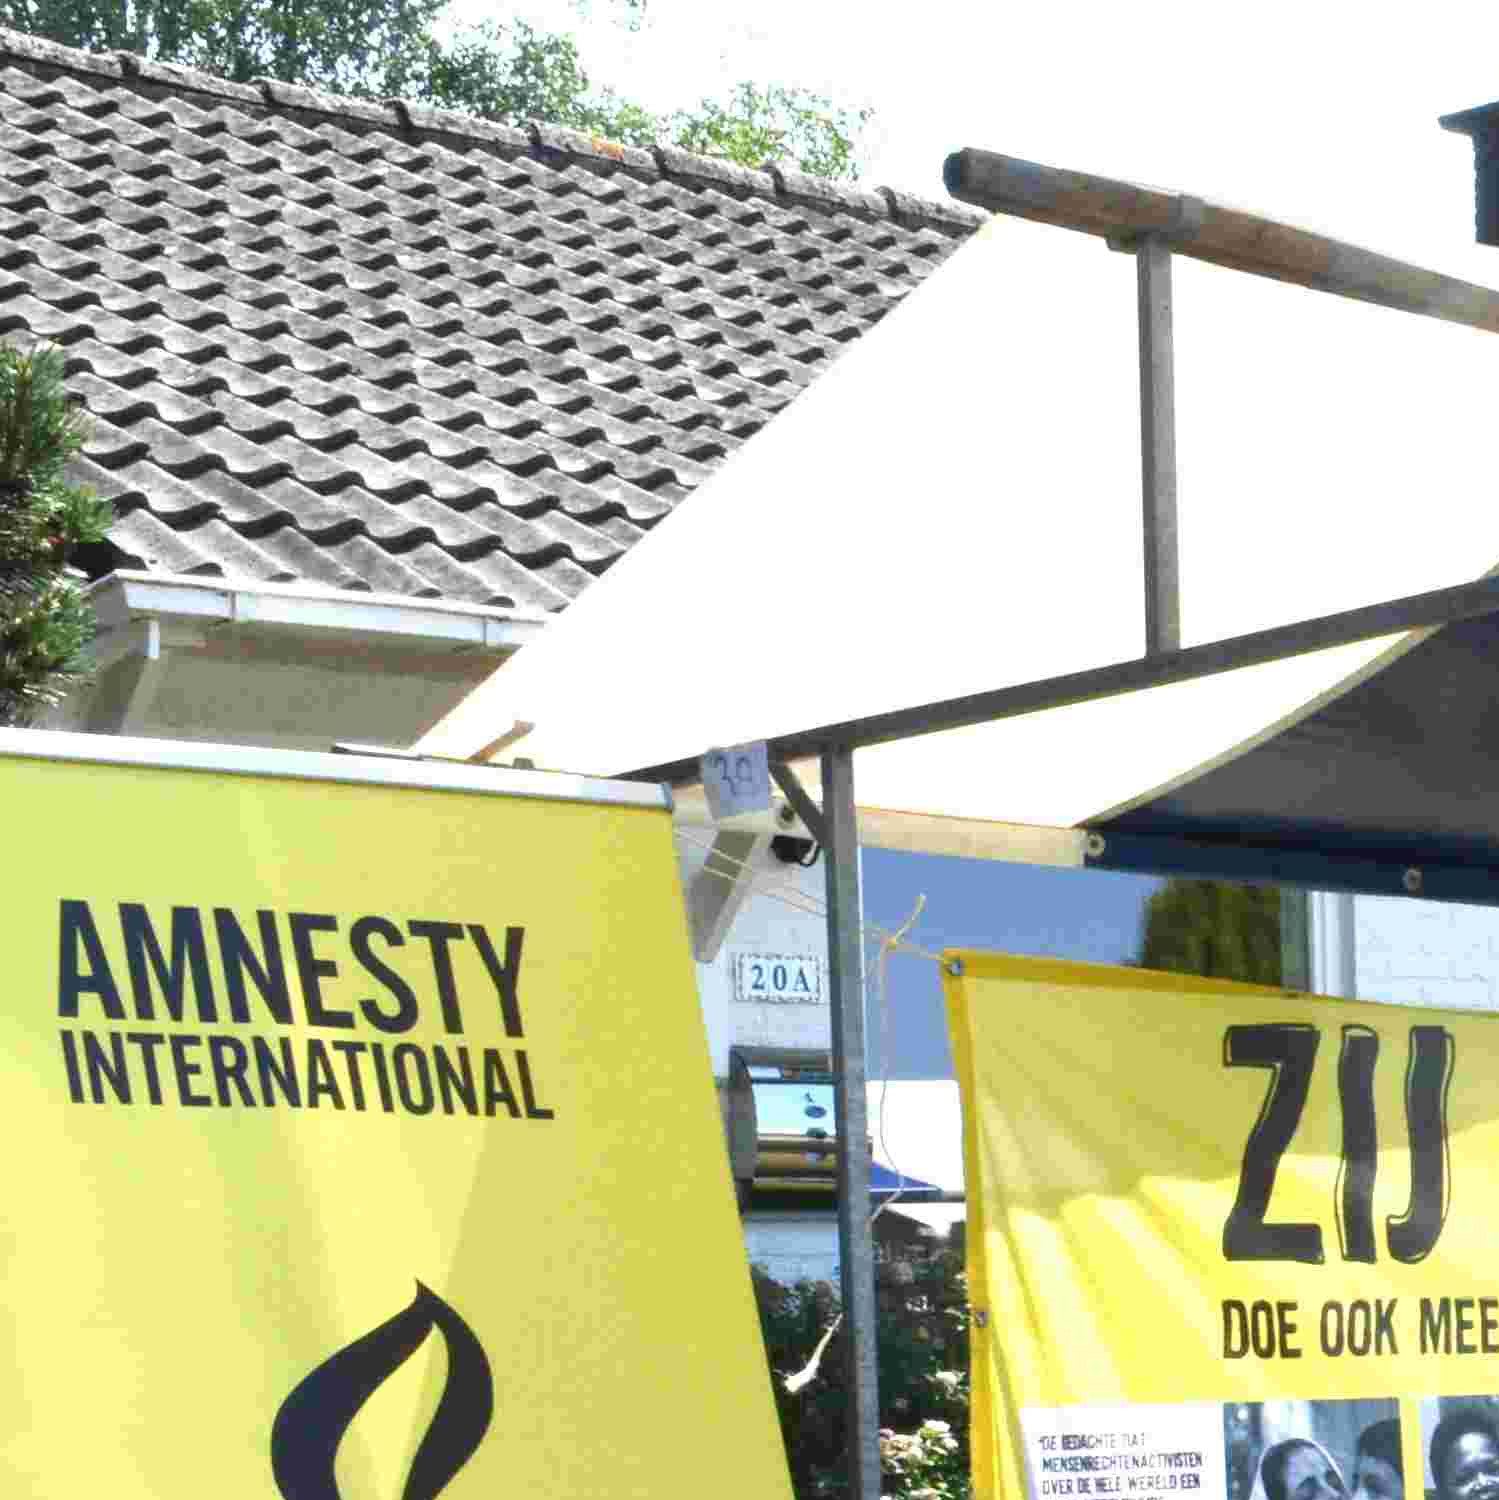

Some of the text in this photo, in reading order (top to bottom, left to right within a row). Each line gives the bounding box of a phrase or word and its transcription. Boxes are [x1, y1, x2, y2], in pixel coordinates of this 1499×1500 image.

[58, 898, 525, 1038] AMNESTY
[751, 964, 810, 992] 20A
[60, 1030, 555, 1121] INTERNATIONAL
[1222, 1022, 1456, 1265] ZIJ
[1222, 1297, 1303, 1360] DOE
[1319, 1297, 1399, 1358] OOK
[1042, 1477, 1073, 1496] OVER
[1077, 1477, 1092, 1494] DE
[1128, 1474, 1177, 1491] WERELD
